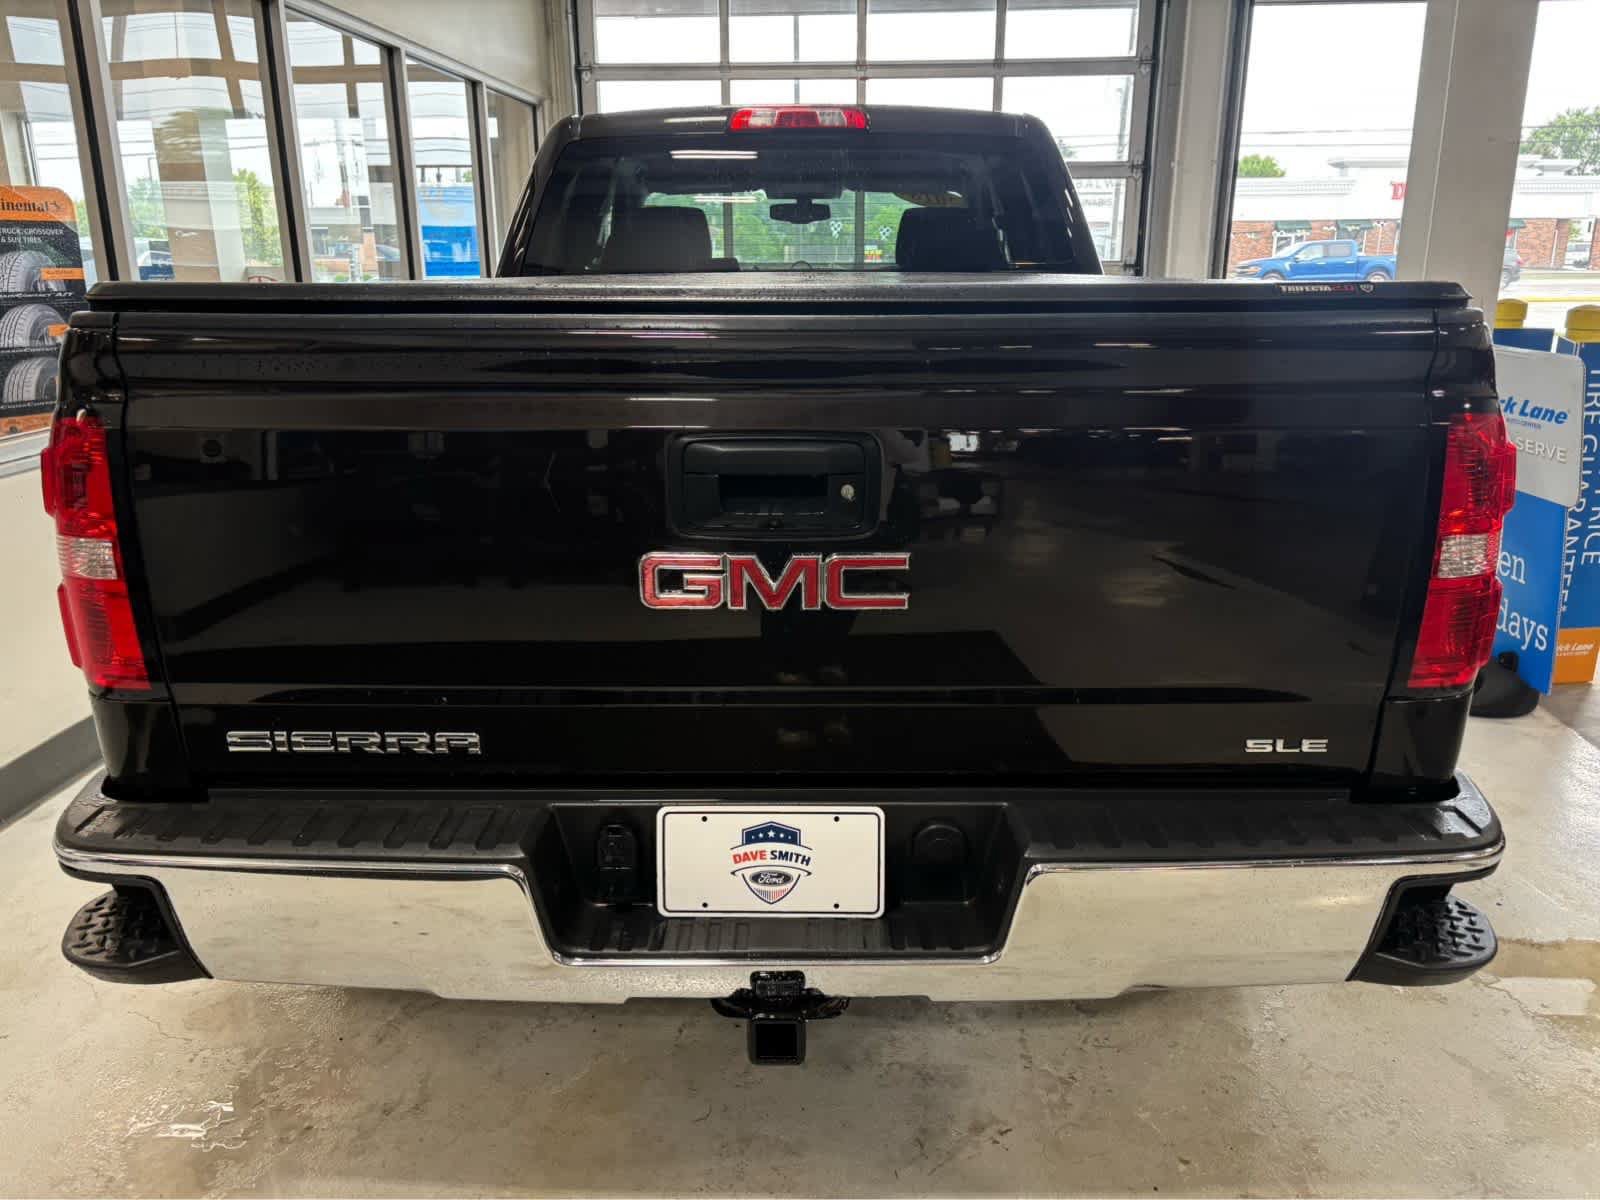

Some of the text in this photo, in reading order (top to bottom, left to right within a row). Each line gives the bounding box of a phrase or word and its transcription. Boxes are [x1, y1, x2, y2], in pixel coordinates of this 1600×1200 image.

[1519, 400, 1568, 425] Lane
[1517, 438, 1568, 465] SERVE
[1581, 488, 1600, 566] RICE
[638, 552, 911, 610] GMC
[226, 731, 481, 754] SIERRA
[1245, 739, 1328, 752] SLE
[732, 849, 811, 866] DAVE SMITH
[758, 872, 784, 884] Ford
